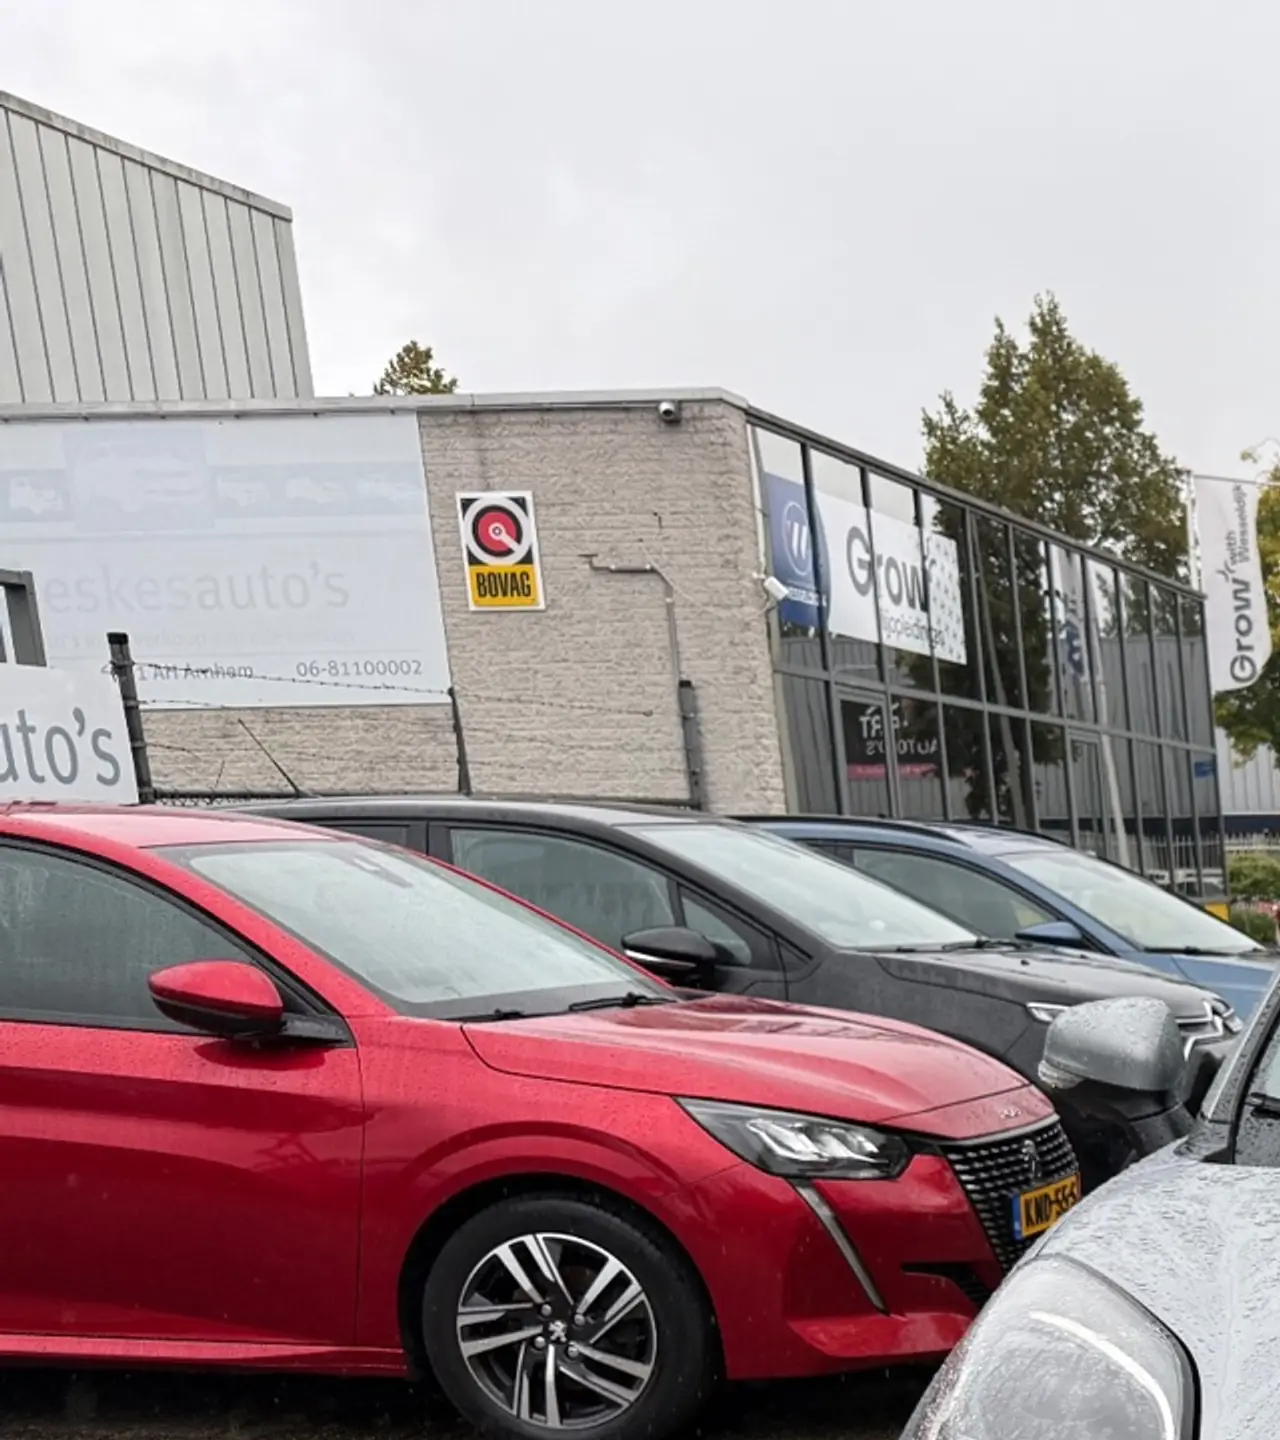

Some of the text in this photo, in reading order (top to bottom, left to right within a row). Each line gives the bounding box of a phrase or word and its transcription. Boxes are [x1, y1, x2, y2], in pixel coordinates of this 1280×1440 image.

[1225, 530, 1238, 565] with
[476, 571, 532, 598] BOVAG
[1230, 577, 1257, 683] Grow
[296, 659, 422, 677] 06-81100002
